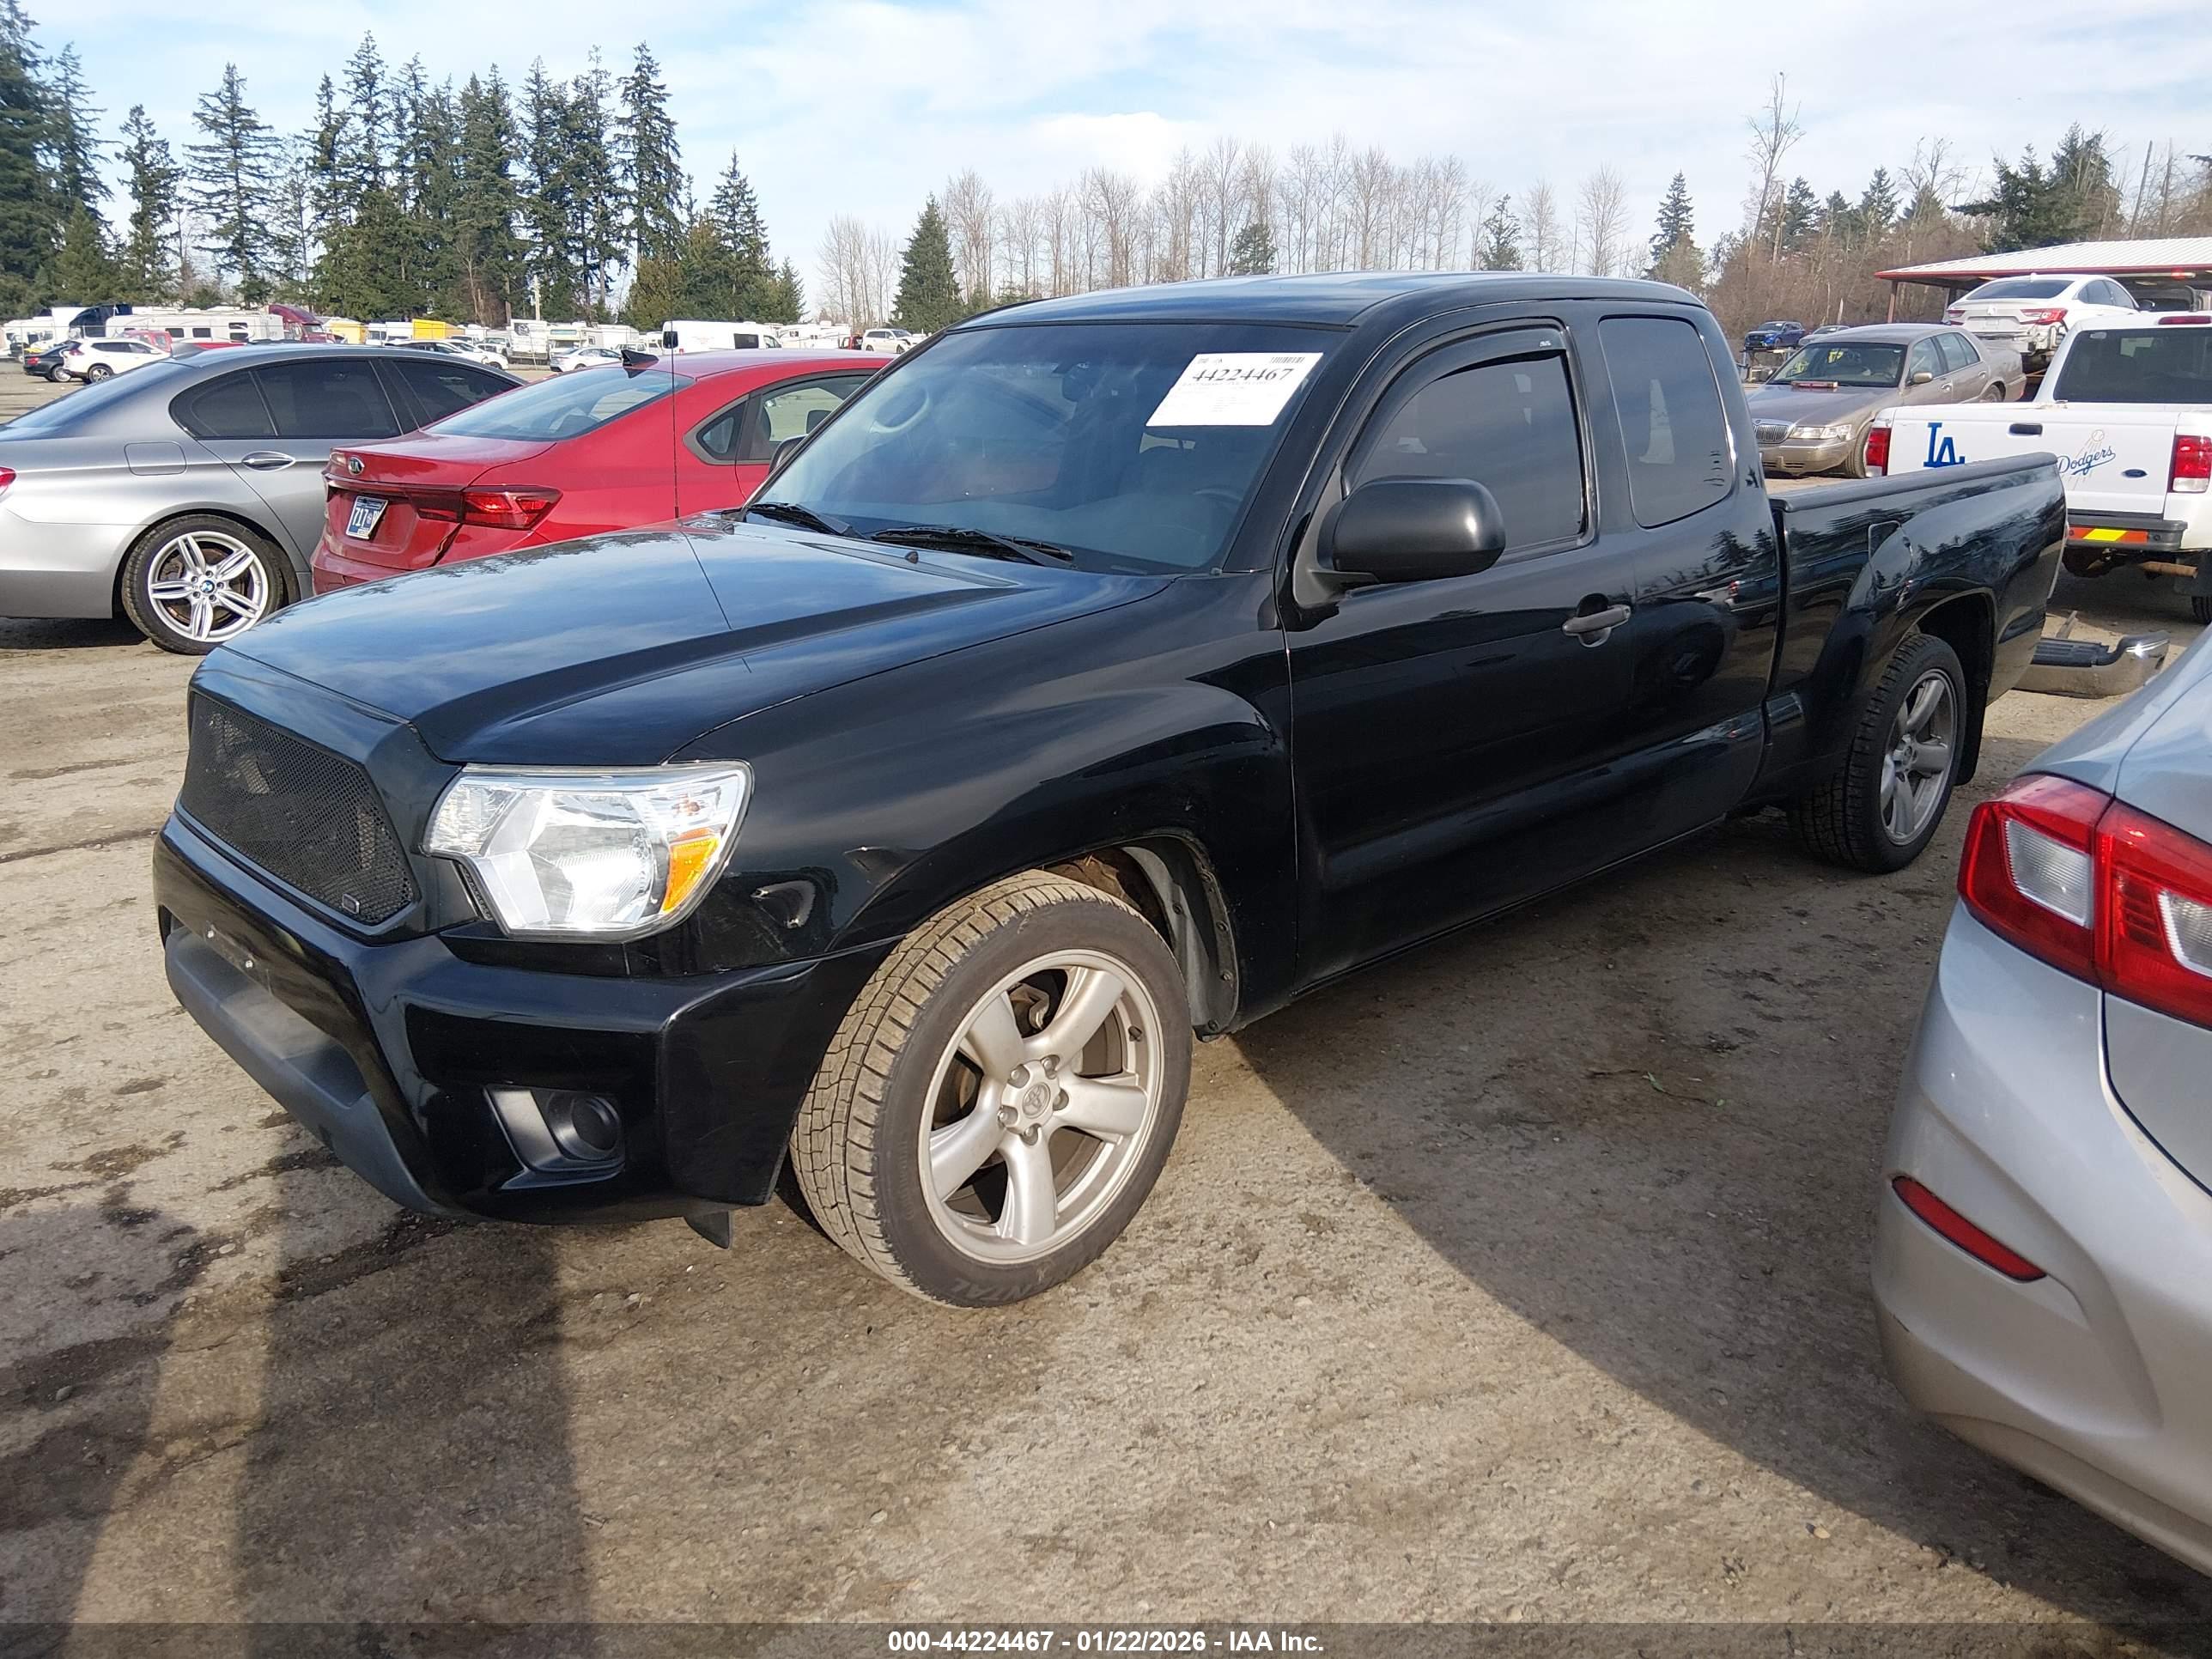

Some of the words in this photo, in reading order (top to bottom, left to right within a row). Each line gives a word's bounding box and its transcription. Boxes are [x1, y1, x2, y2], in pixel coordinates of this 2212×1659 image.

[1193, 368, 1294, 382] 44224467
[1923, 422, 1965, 468] LA
[2057, 446, 2116, 475] Dodgers
